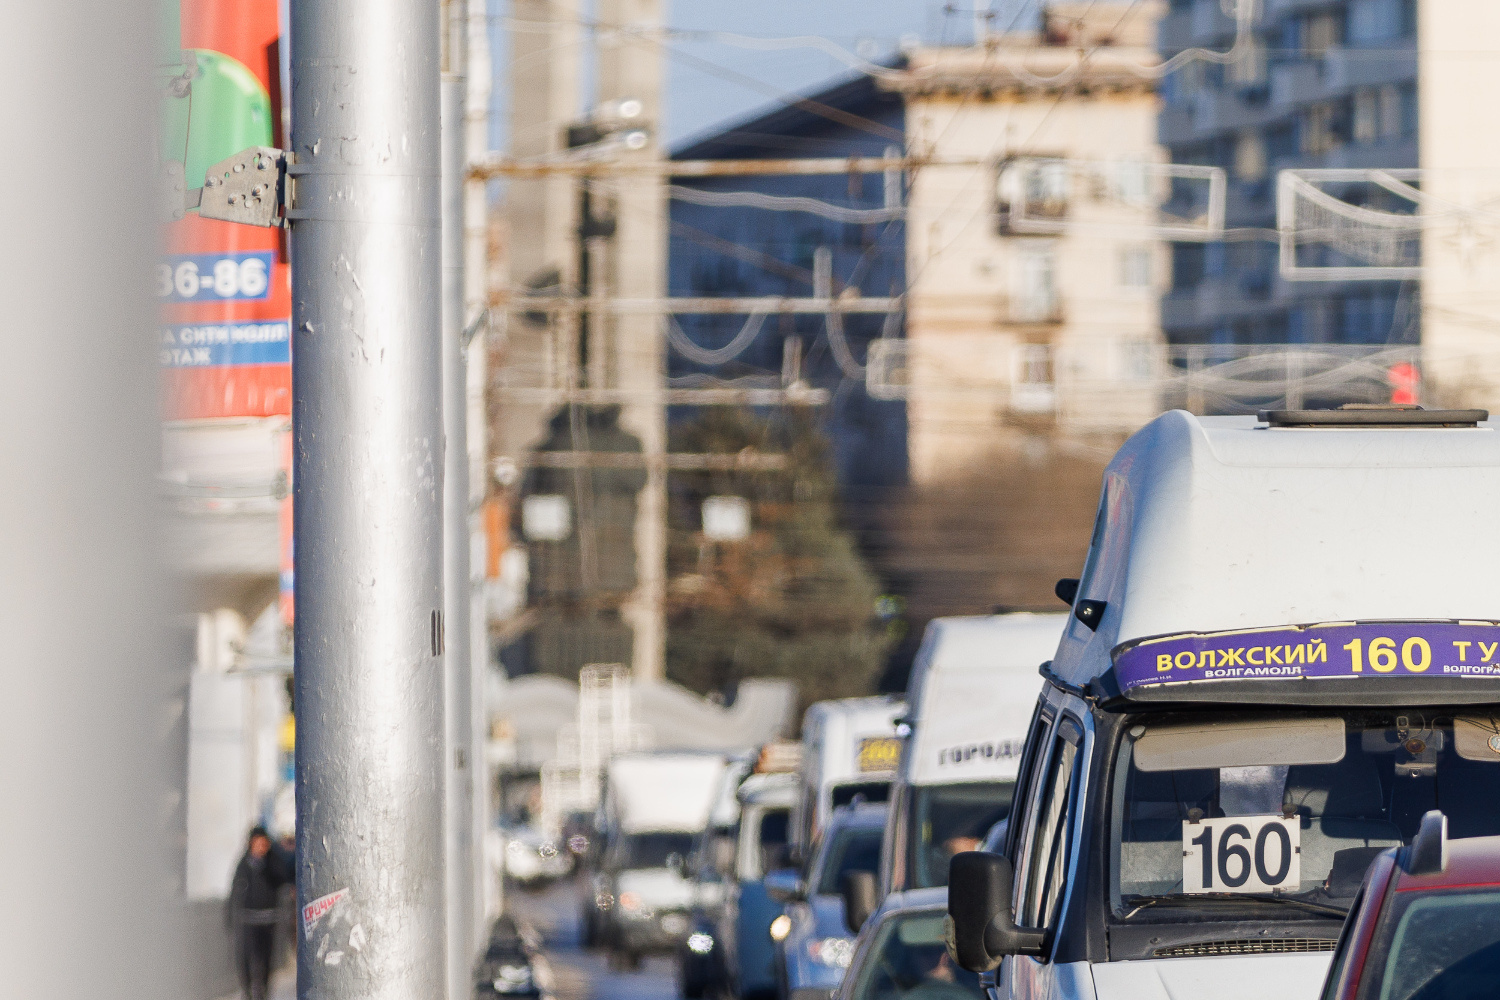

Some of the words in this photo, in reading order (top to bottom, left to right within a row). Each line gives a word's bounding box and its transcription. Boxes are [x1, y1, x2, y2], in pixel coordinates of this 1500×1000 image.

[1156, 637, 1328, 672] ВОЛЖСКИЙ
[1343, 636, 1432, 673] 160
[1205, 666, 1302, 678] ВОЛГАМОЛЛ
[1191, 821, 1292, 889] 160
